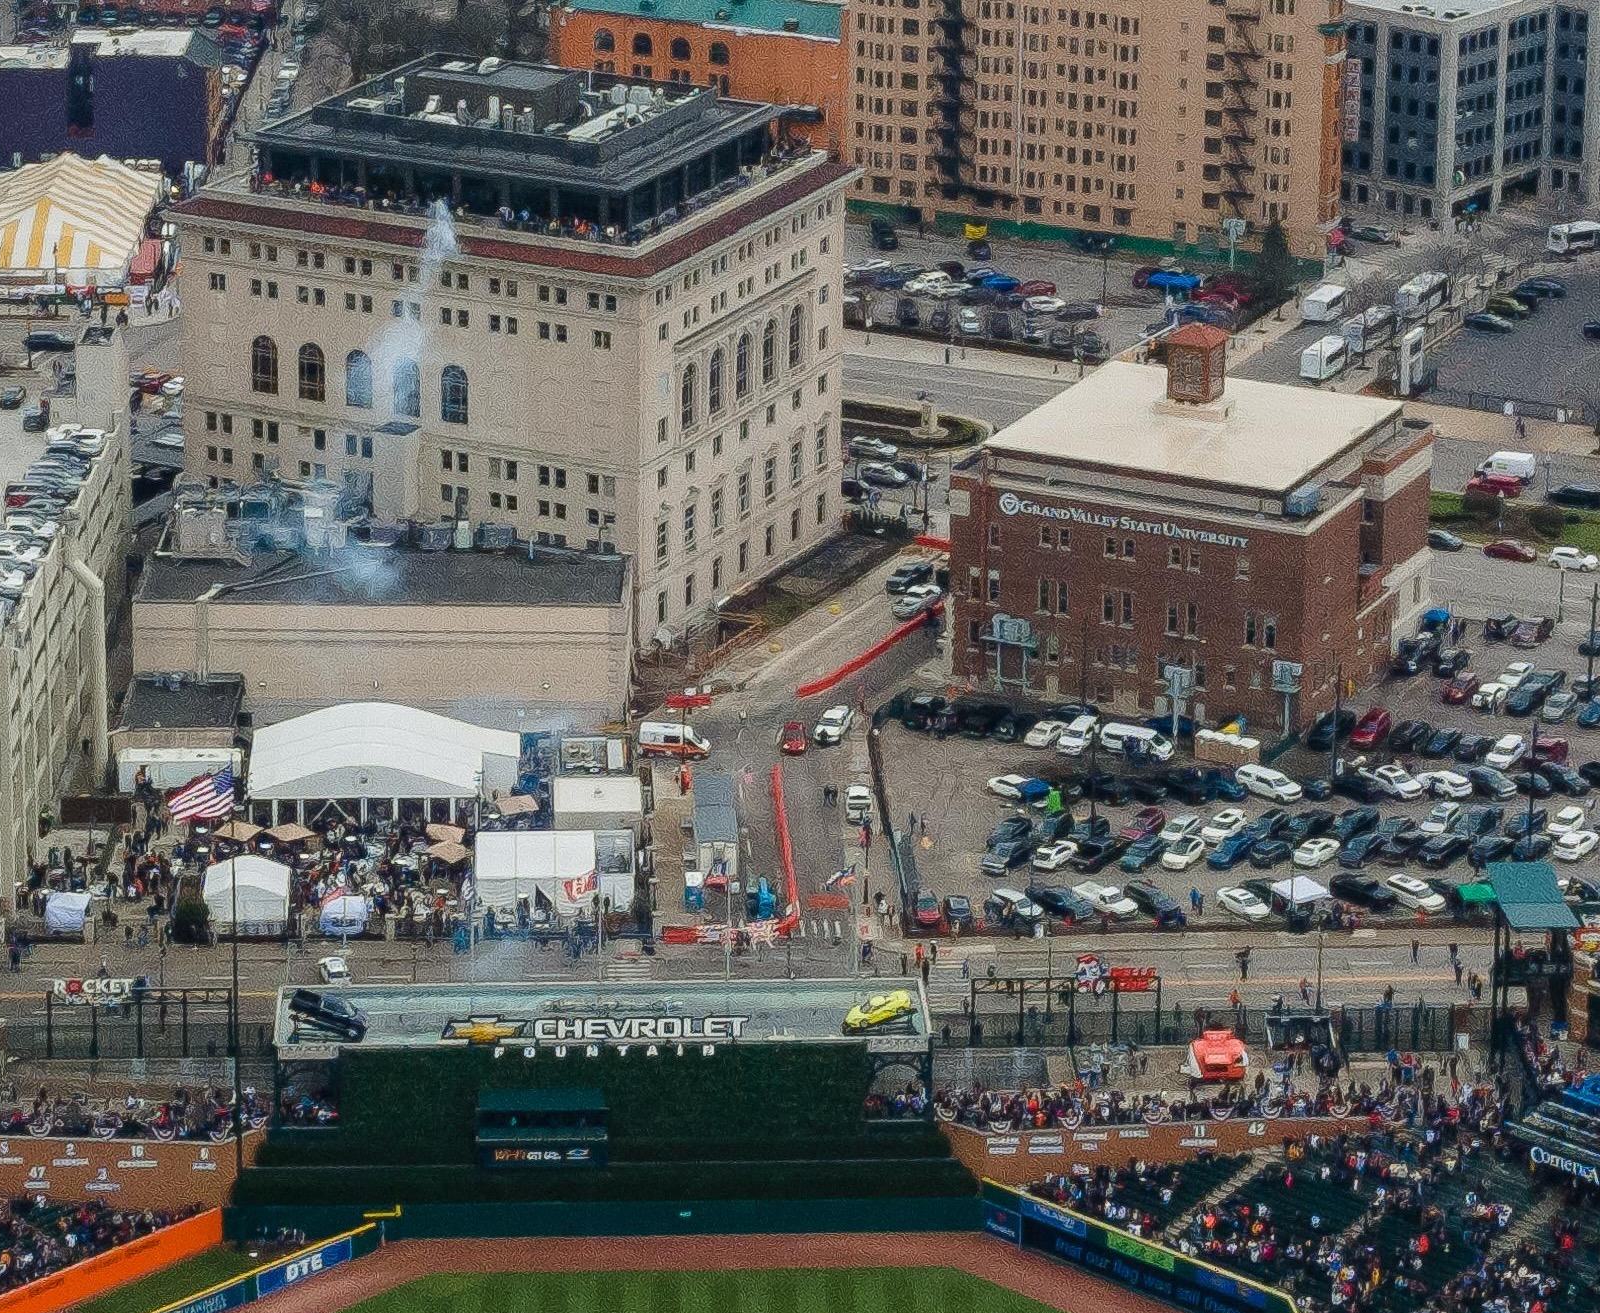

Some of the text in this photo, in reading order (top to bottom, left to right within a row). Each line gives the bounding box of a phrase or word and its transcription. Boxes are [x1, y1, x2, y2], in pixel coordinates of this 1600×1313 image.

[1019, 500, 1249, 549] GRAND VALLEY STATE UNIVERSITY
[53, 977, 135, 997] ROCKET
[534, 1016, 752, 1040] CHEVROLET
[493, 1043, 716, 1059] FOUNTAIN
[285, 1252, 324, 1283] DTE
[1112, 1257, 1140, 1285] flag
[1142, 1269, 1173, 1295] was
